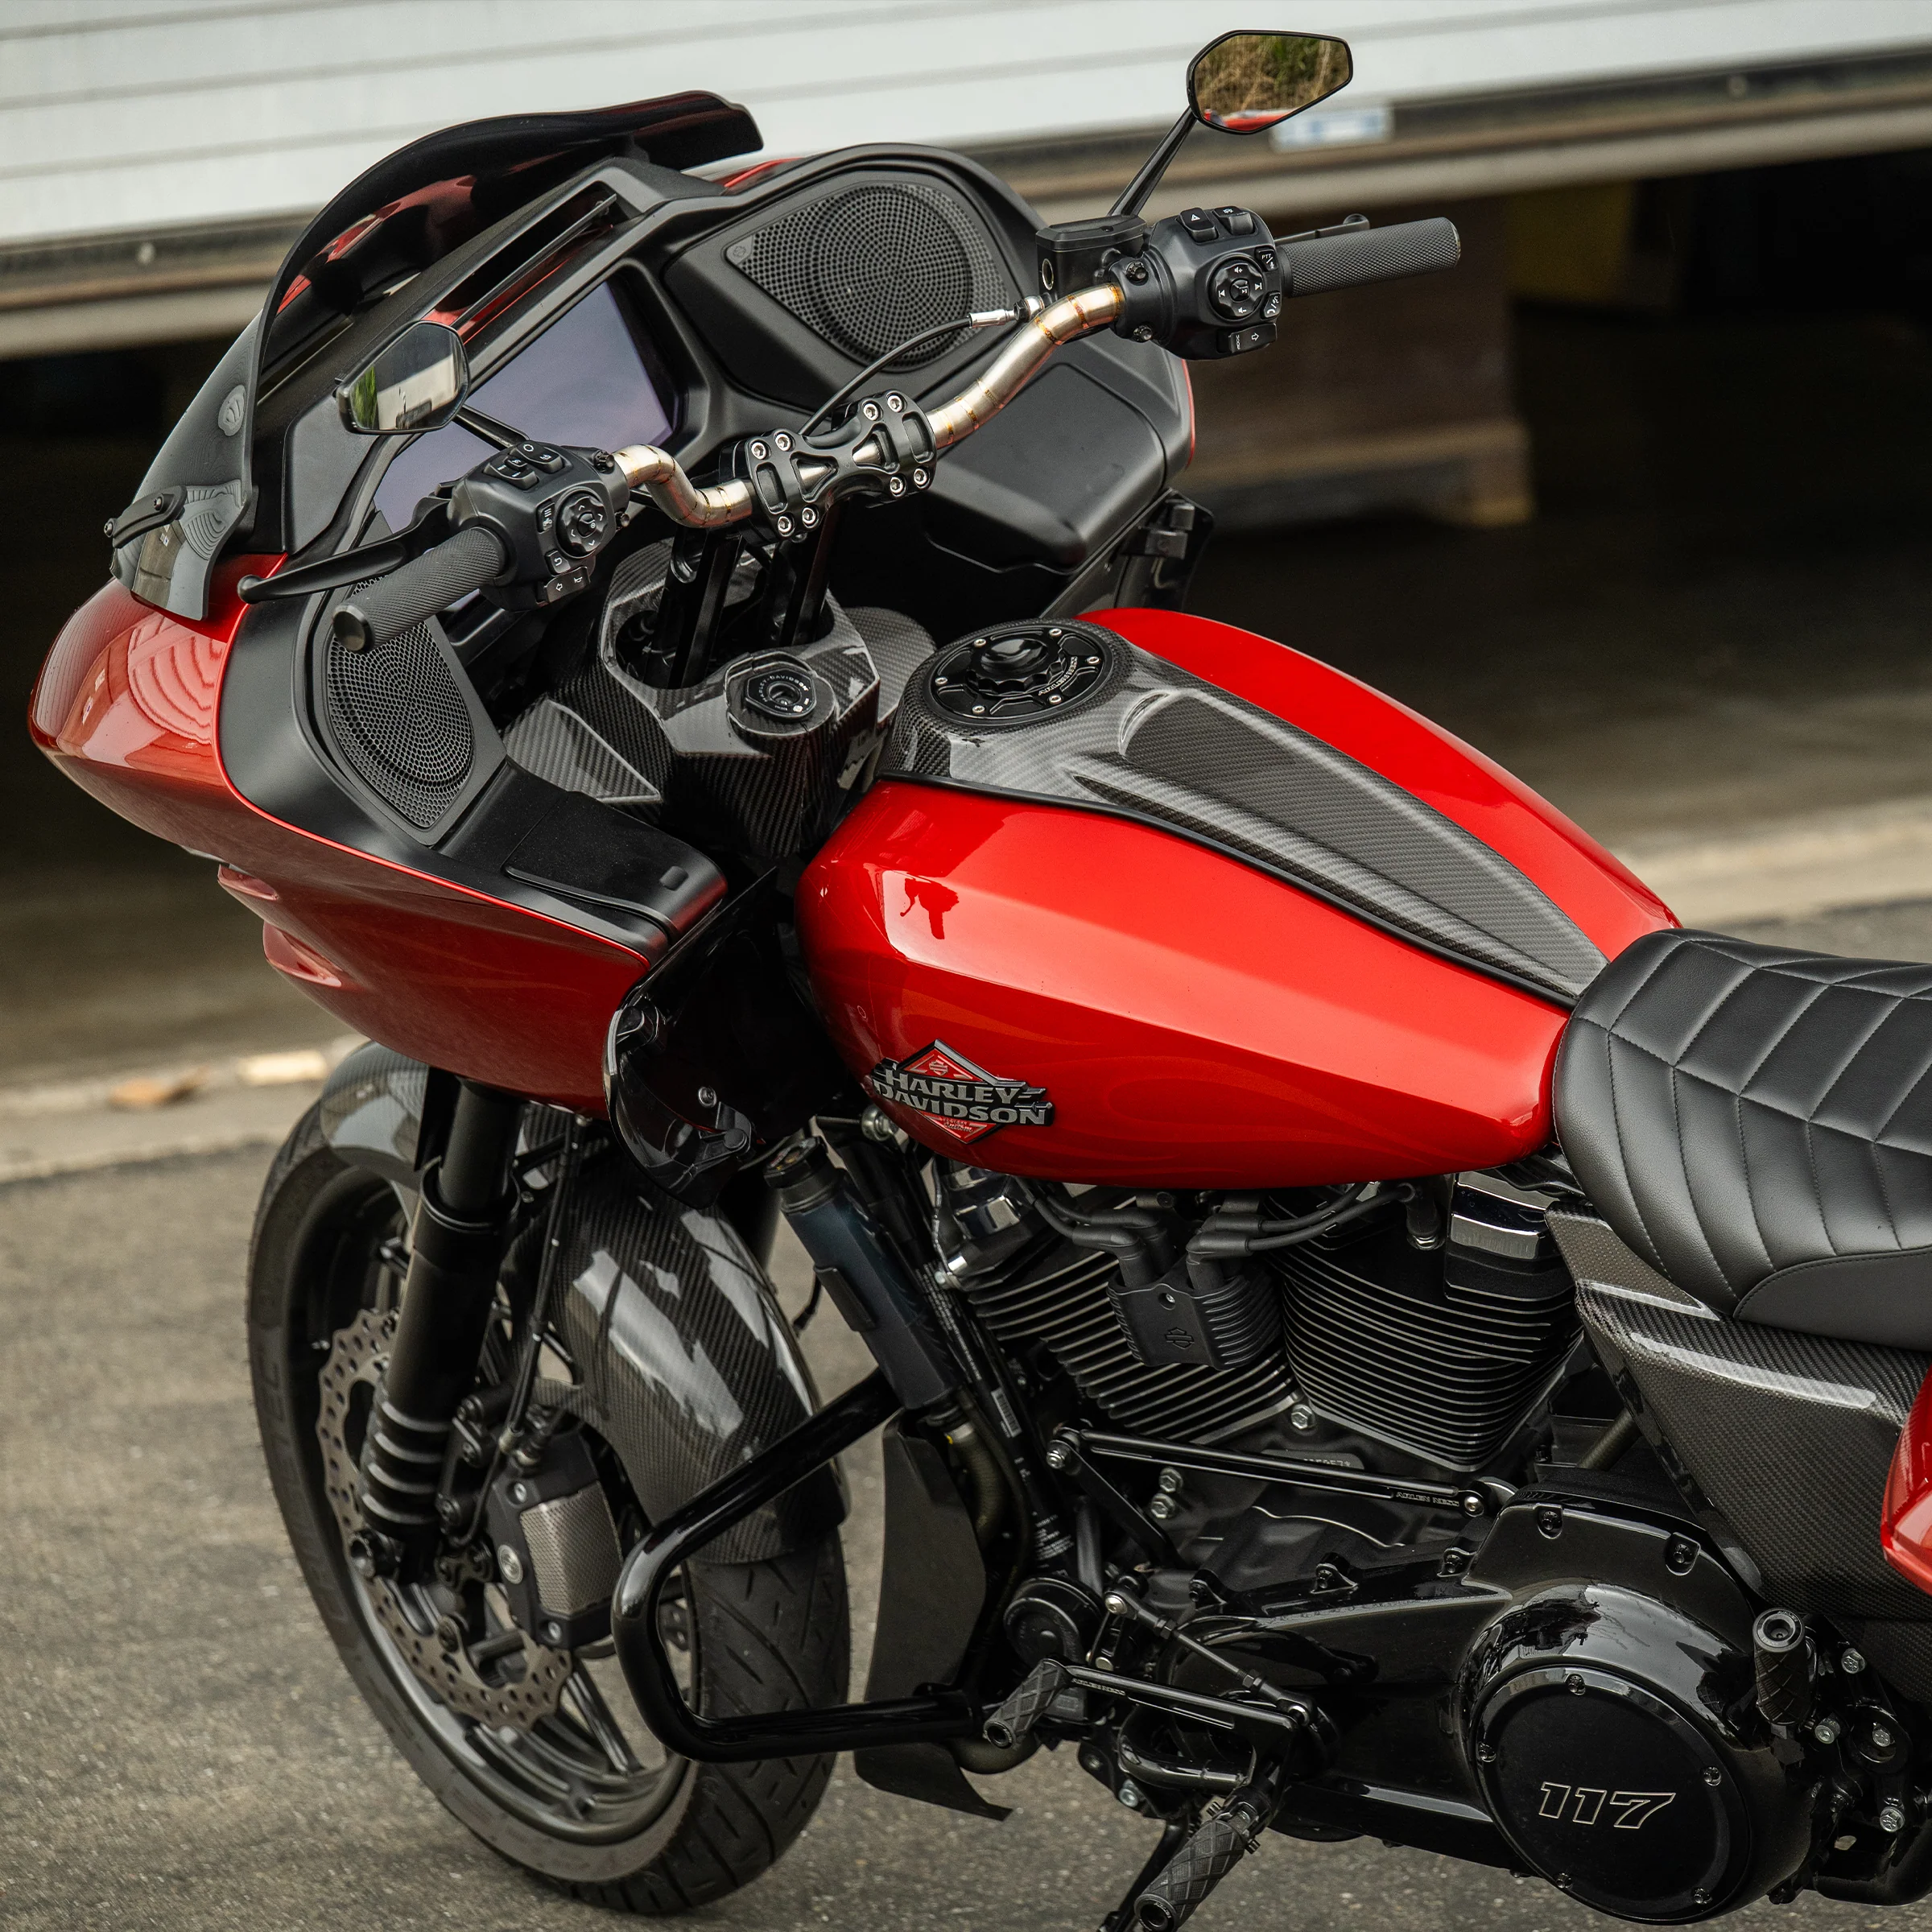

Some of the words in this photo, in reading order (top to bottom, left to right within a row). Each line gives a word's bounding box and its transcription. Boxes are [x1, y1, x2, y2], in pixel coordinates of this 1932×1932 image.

[873, 1080, 1046, 1125] DAVIDSON
[885, 1069, 1020, 1104] HARLEY
[1538, 1781, 1676, 1829] 117
